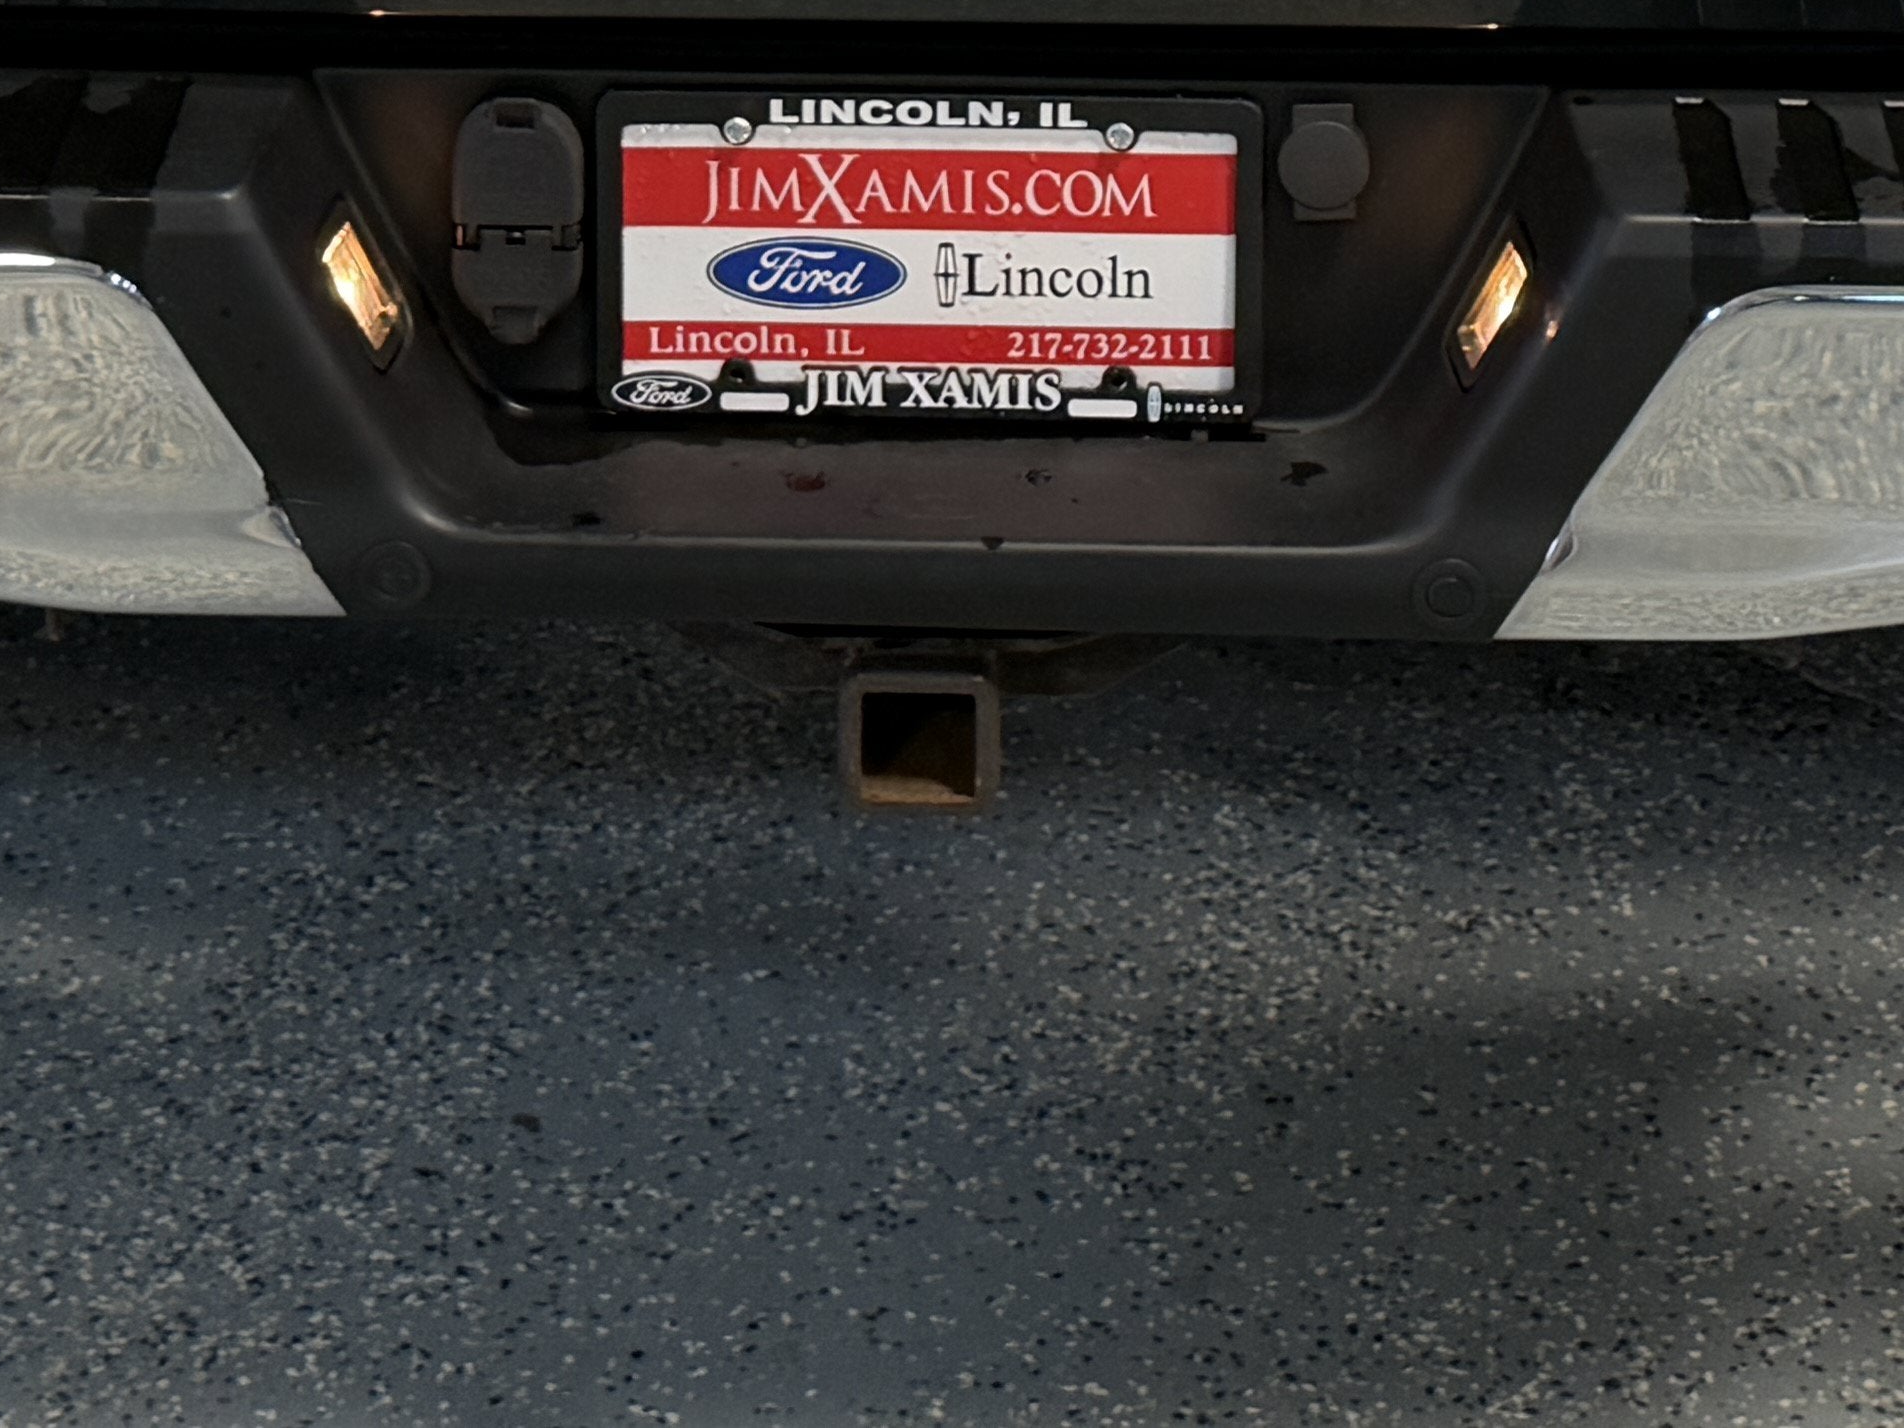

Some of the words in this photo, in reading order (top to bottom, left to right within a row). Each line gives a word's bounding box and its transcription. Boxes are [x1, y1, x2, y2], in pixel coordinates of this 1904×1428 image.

[768, 97, 1022, 128] LINCOLN,
[1038, 101, 1089, 129] IL
[701, 152, 1159, 225] JIMXAMIS.COM
[745, 244, 868, 300] Ford
[960, 250, 1154, 300] Lincoln
[647, 324, 810, 360] Lincoln,
[824, 329, 866, 356] IL
[1006, 330, 1213, 361] 217-732-2111
[627, 378, 693, 406] Ford
[795, 367, 889, 416] JIM
[899, 370, 1064, 412] XAMIS
